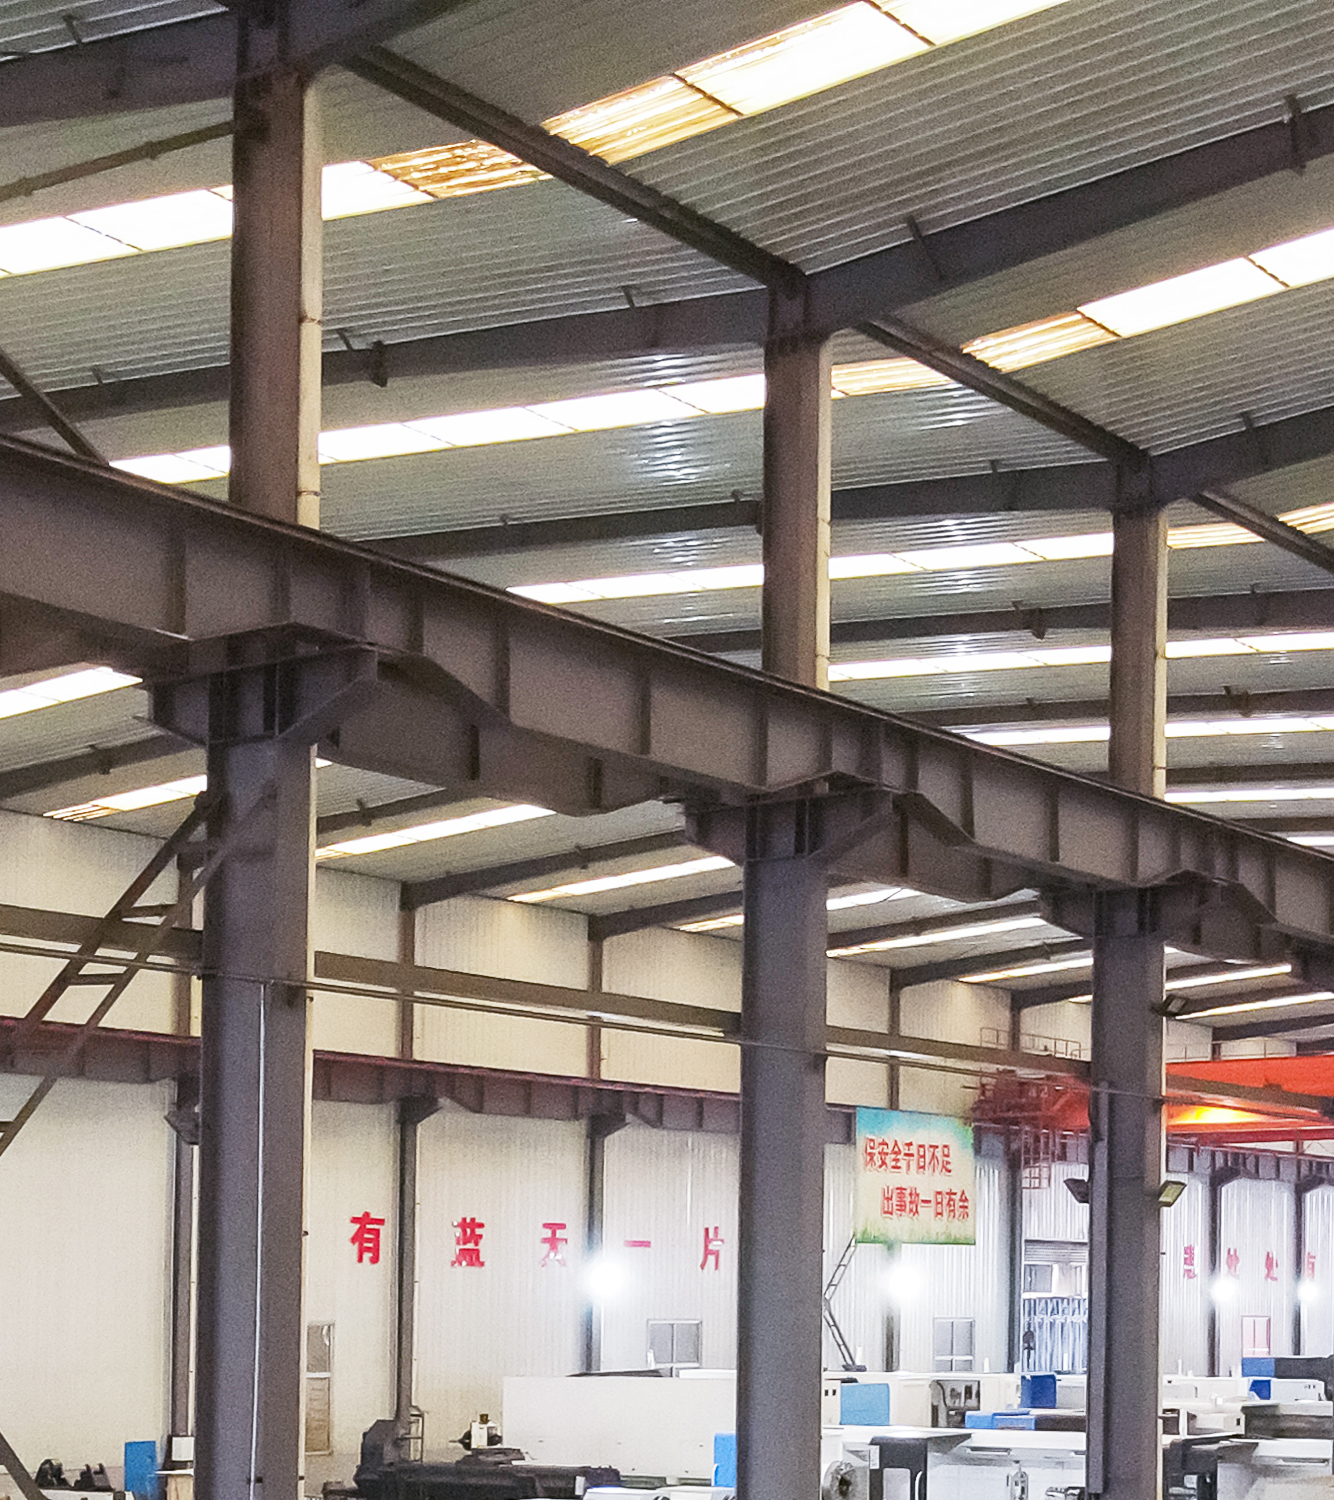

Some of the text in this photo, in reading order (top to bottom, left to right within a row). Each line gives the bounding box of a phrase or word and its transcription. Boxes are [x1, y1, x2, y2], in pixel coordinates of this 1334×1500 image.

[864, 1137, 952, 1174] 保安全千日不足
[882, 1185, 970, 1220] 出事故一日有余
[350, 1211, 386, 1265] 有
[451, 1216, 486, 1268] 蓝
[541, 1222, 568, 1267] 天
